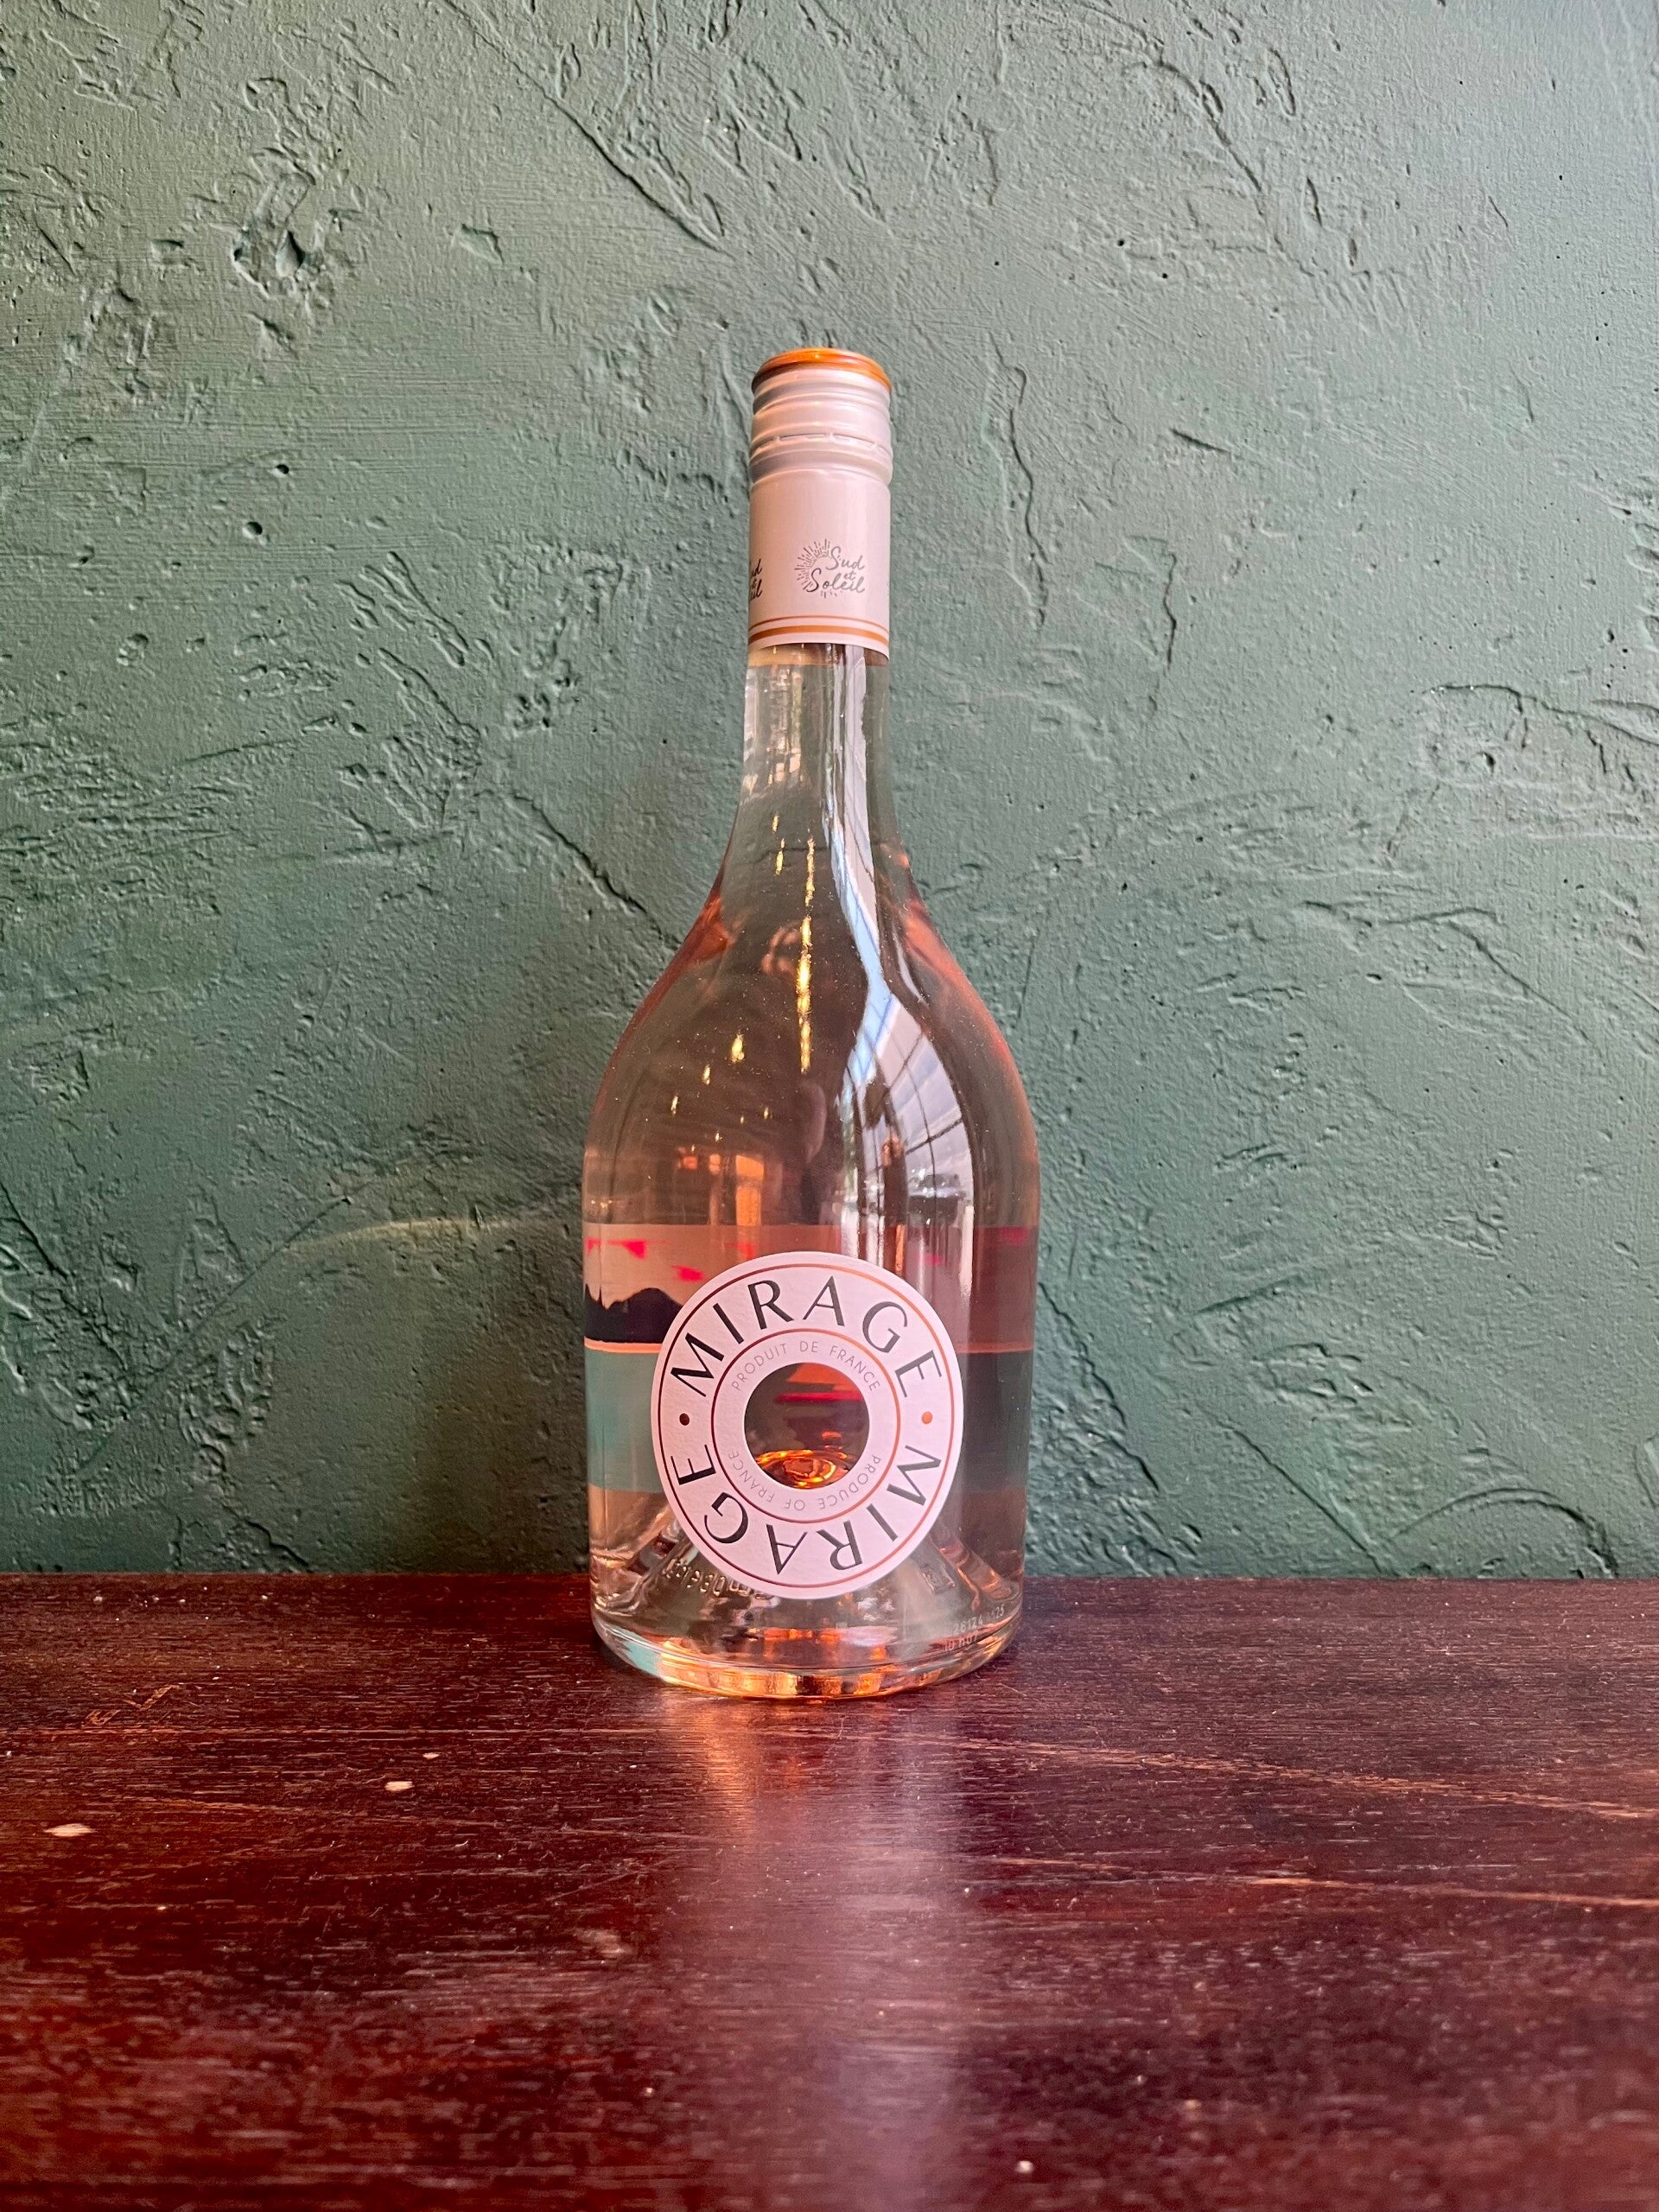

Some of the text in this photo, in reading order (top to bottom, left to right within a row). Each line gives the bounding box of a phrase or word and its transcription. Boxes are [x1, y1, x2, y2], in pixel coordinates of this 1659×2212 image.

[806, 568, 865, 594] Soleil
[826, 546, 865, 571] Sud
[843, 571, 855, 581] et
[670, 1274, 944, 1398] MIRAGE
[731, 1340, 880, 1391] PRODUIT DE FRANCE
[728, 1451, 881, 1511] PRODUCE OF FRANCE
[670, 1443, 943, 1575] MIRAGE
